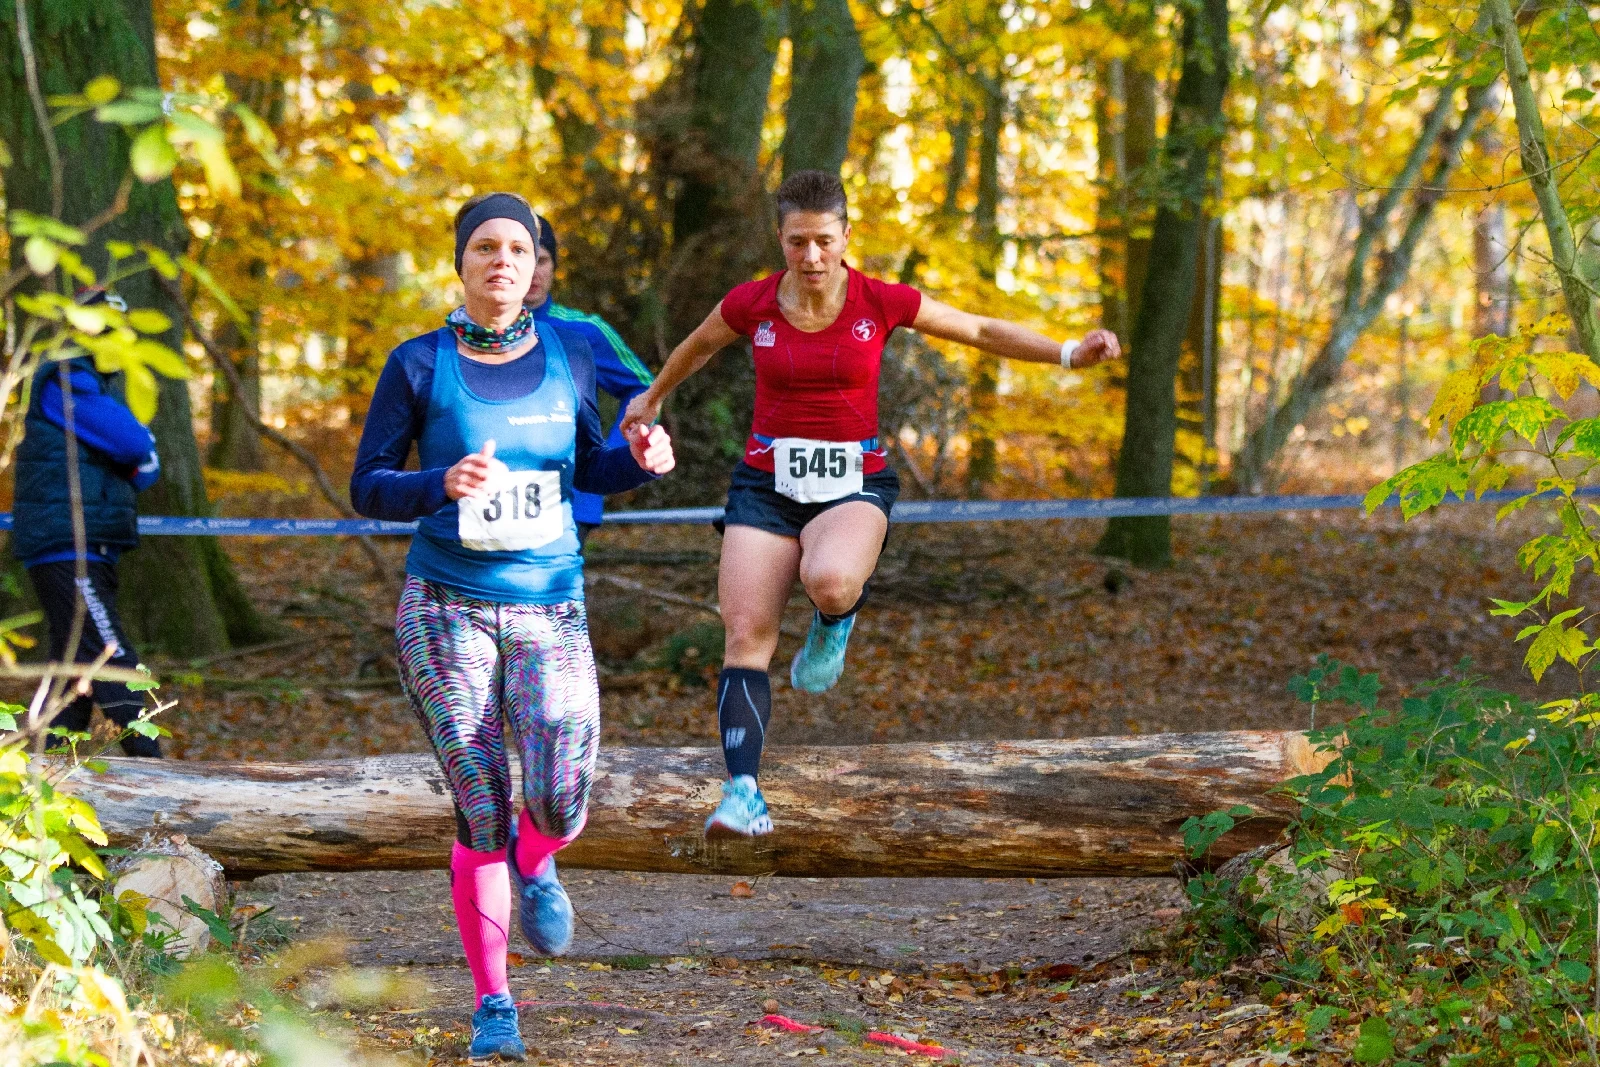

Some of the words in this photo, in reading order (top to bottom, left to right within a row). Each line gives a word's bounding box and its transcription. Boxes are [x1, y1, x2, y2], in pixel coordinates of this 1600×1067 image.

[789, 447, 847, 478] 545
[483, 483, 541, 522] 318
[75, 577, 125, 658] LUFGRUPPE
